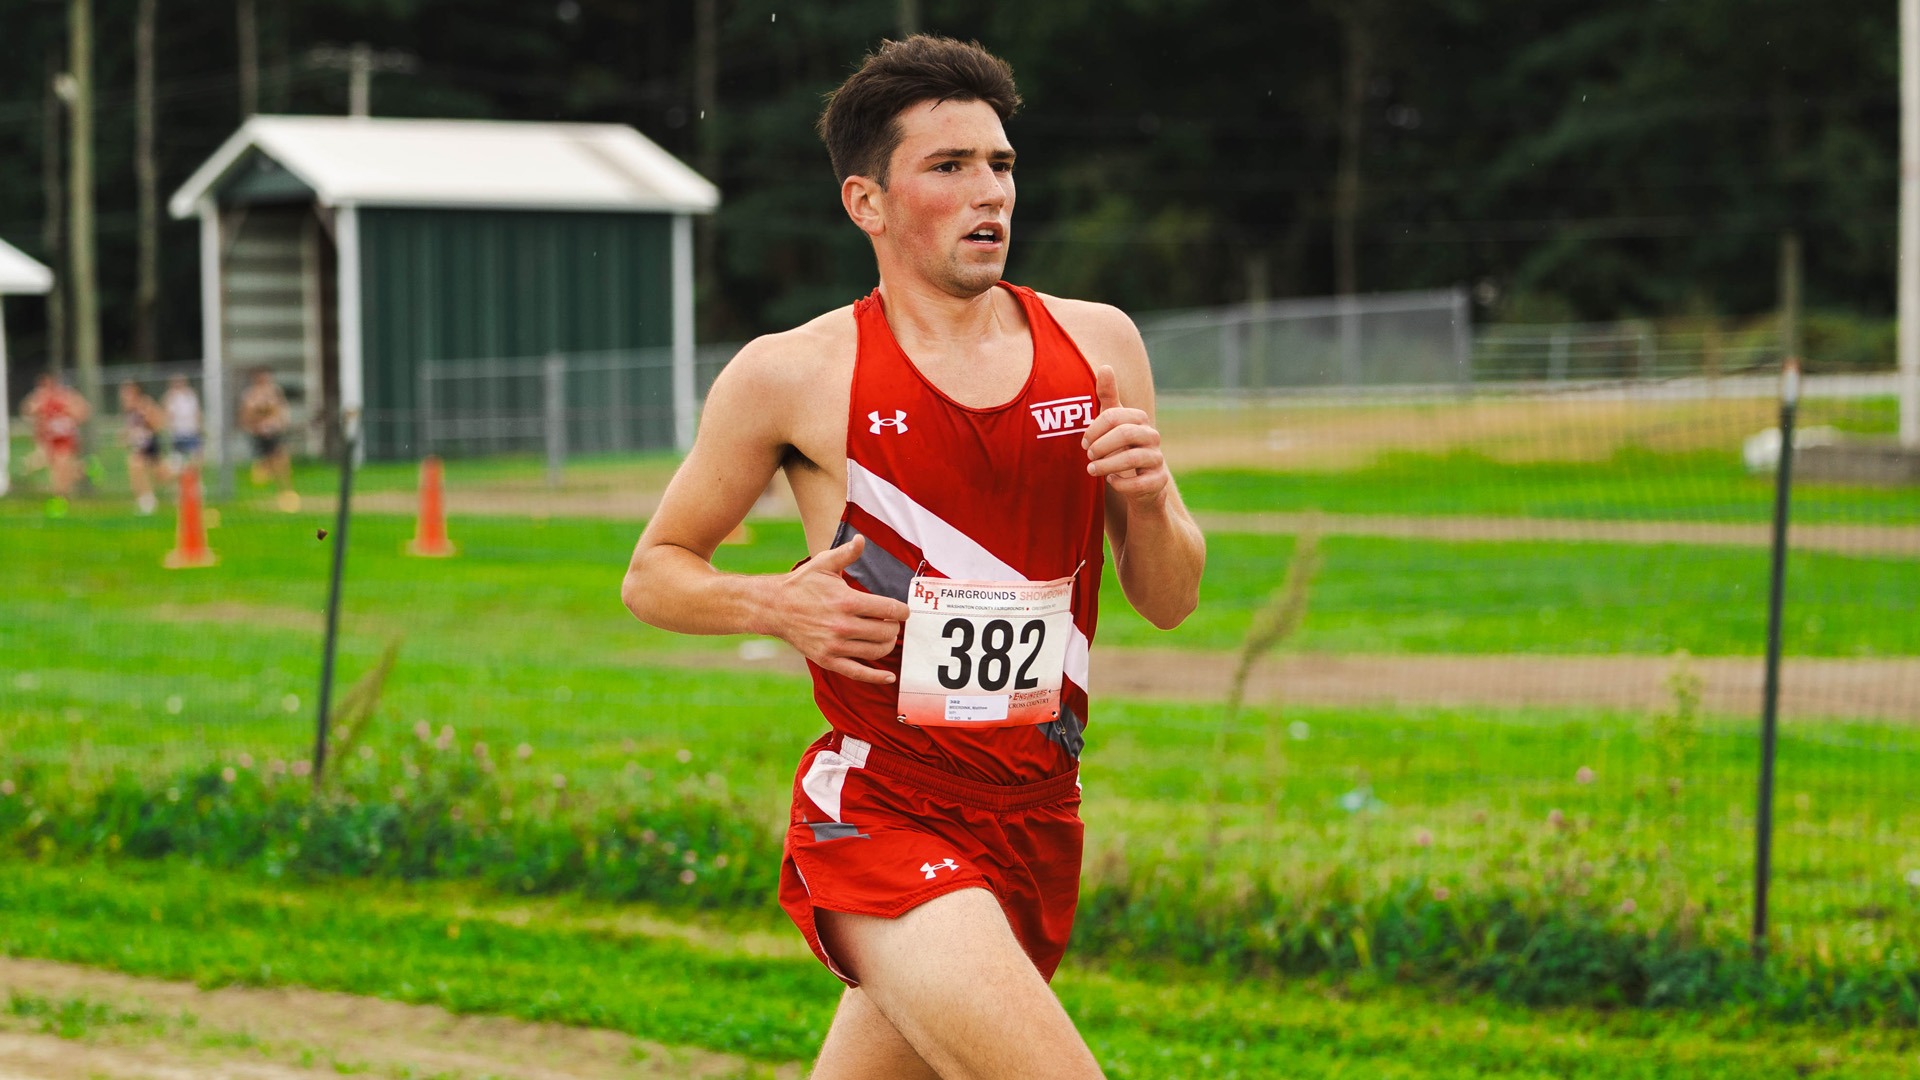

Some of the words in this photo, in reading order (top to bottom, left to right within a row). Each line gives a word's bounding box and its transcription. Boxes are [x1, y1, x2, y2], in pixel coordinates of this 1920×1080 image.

[1031, 402, 1094, 431] WPI
[914, 584, 939, 610] RPI
[940, 588, 1017, 601] FAIRGROUNDS
[1019, 587, 1069, 601] SHOWDOWN
[937, 617, 1046, 692] 382
